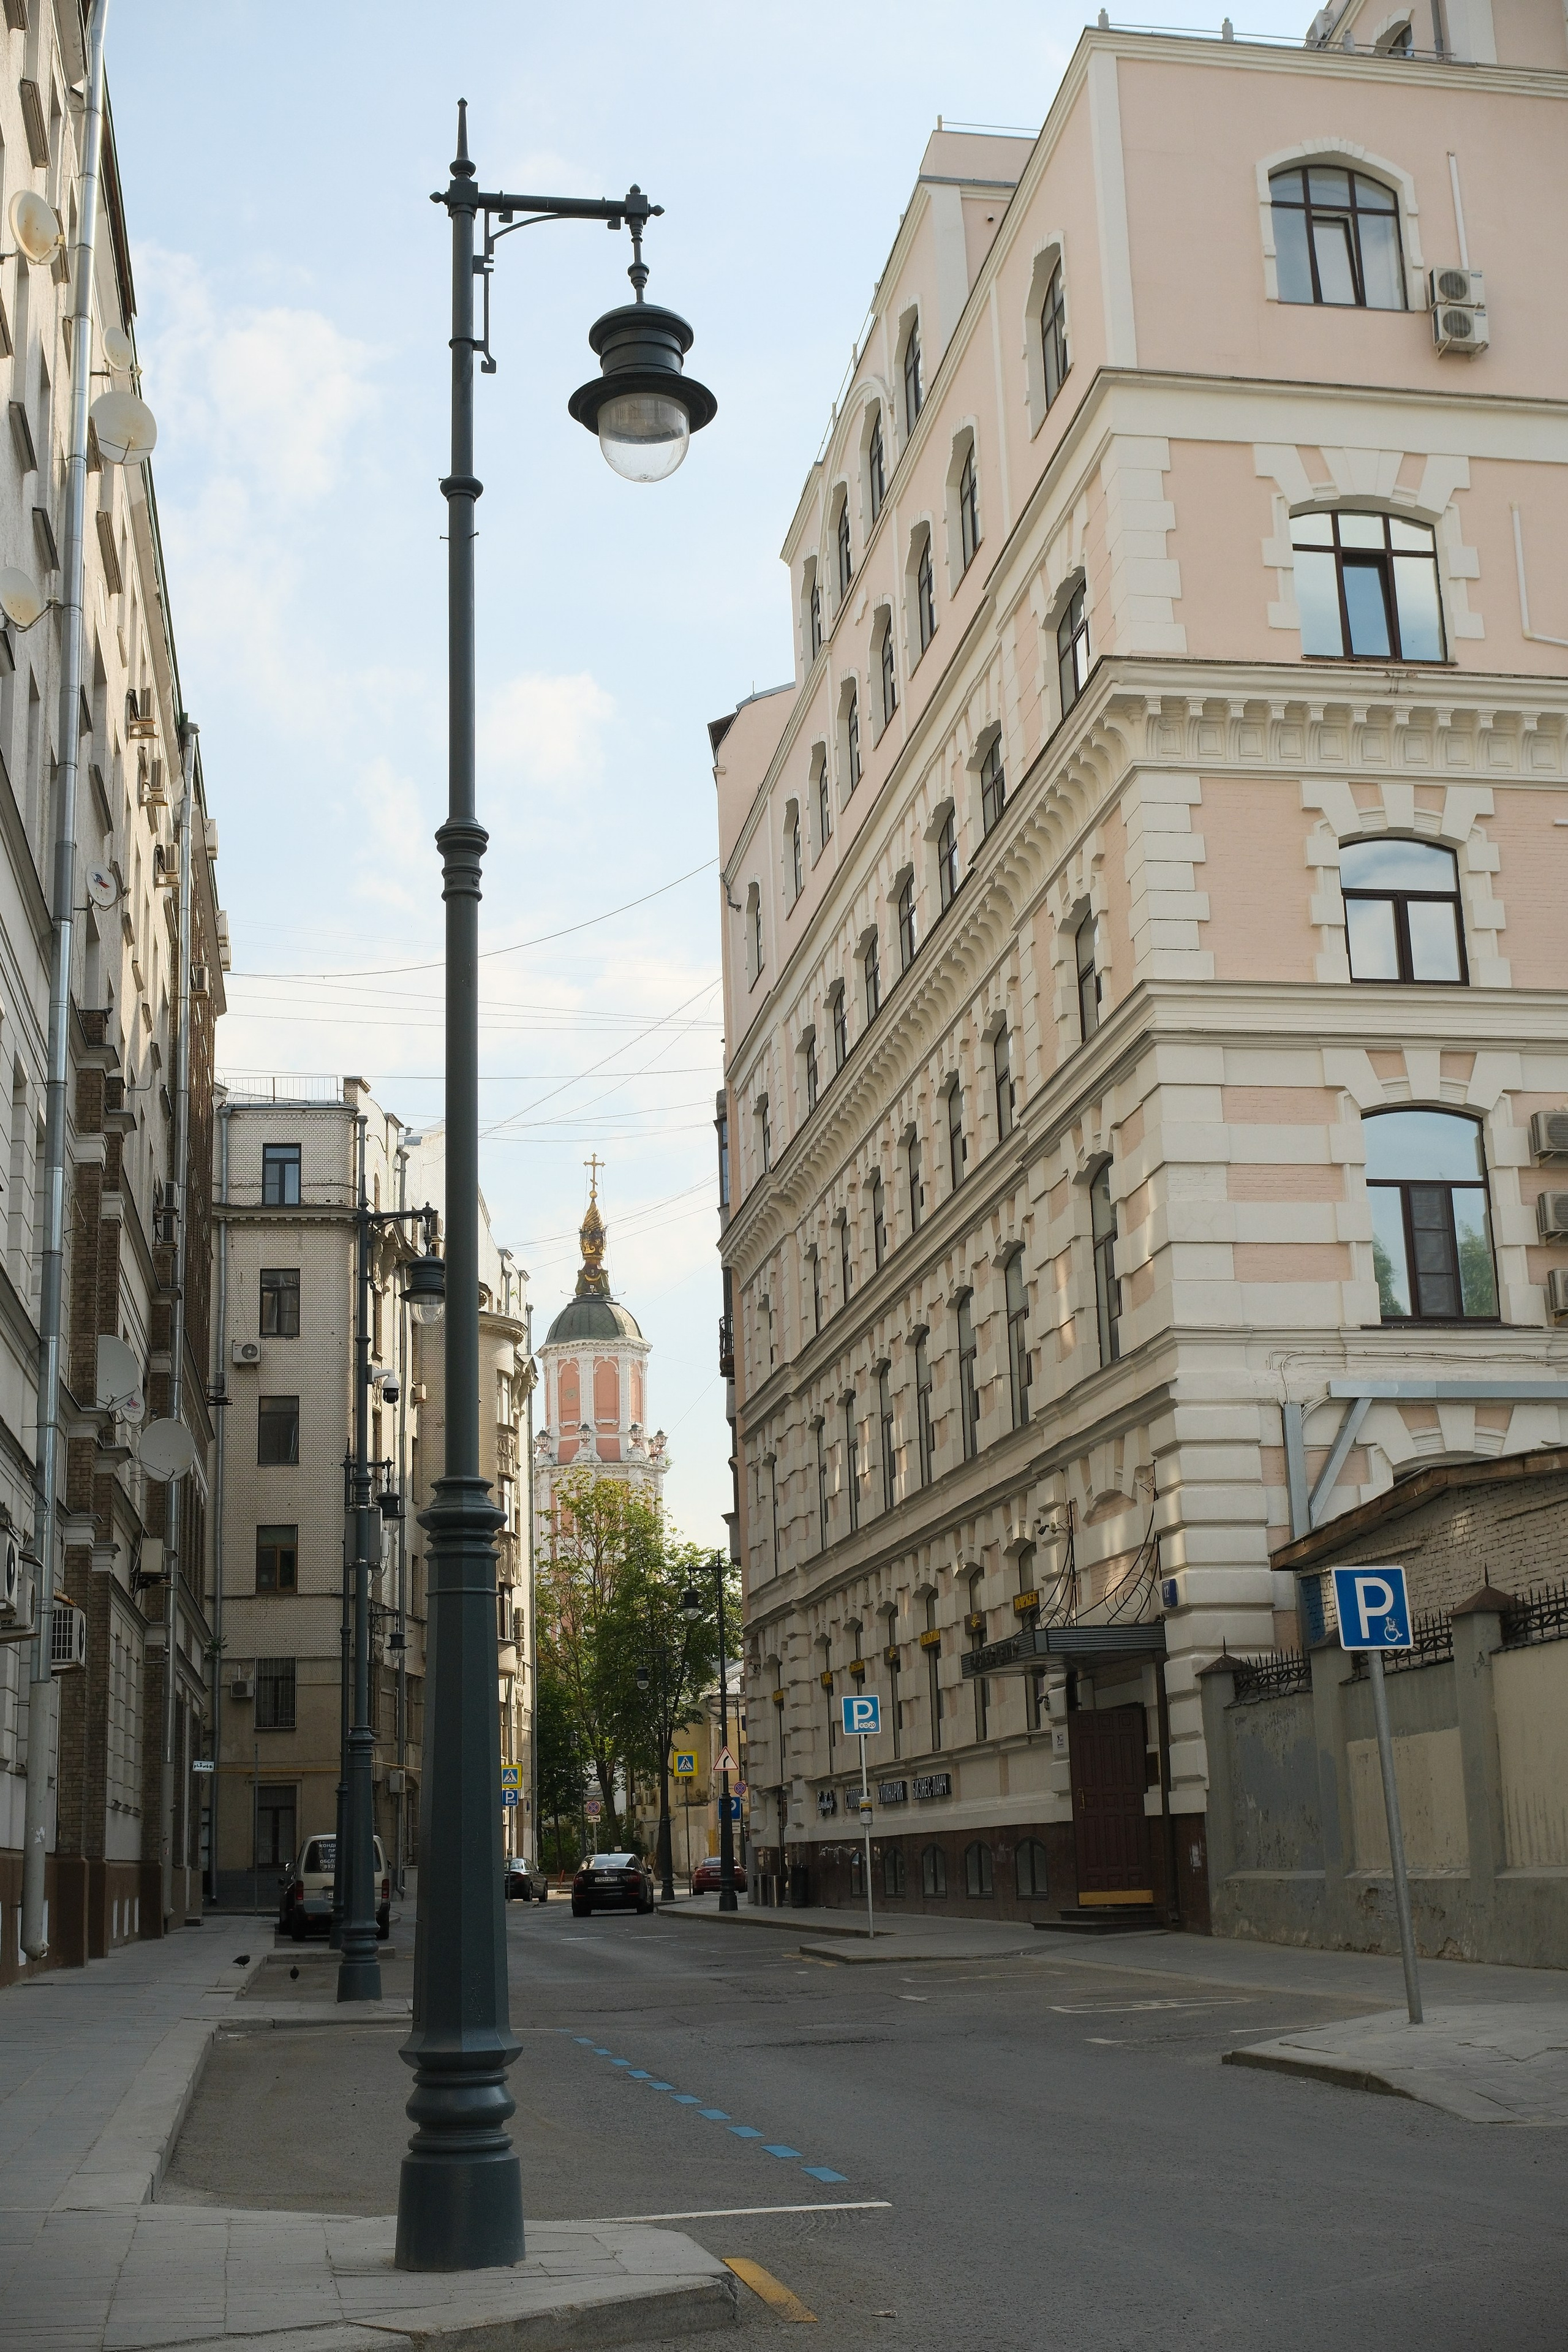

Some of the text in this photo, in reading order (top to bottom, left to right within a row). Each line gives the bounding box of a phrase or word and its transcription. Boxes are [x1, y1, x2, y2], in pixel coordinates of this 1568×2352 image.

[1164, 1585, 1169, 1598] 12
[1354, 1577, 1394, 1639] P
[853, 1700, 873, 1730] P
[878, 1782, 903, 1803] КУЛИНАРИЯ
[913, 1774, 946, 1798] БИЗНЕС-ЛАНЧ
[505, 1791, 515, 1804] P
[846, 1789, 864, 1807] СТОЛОВ
